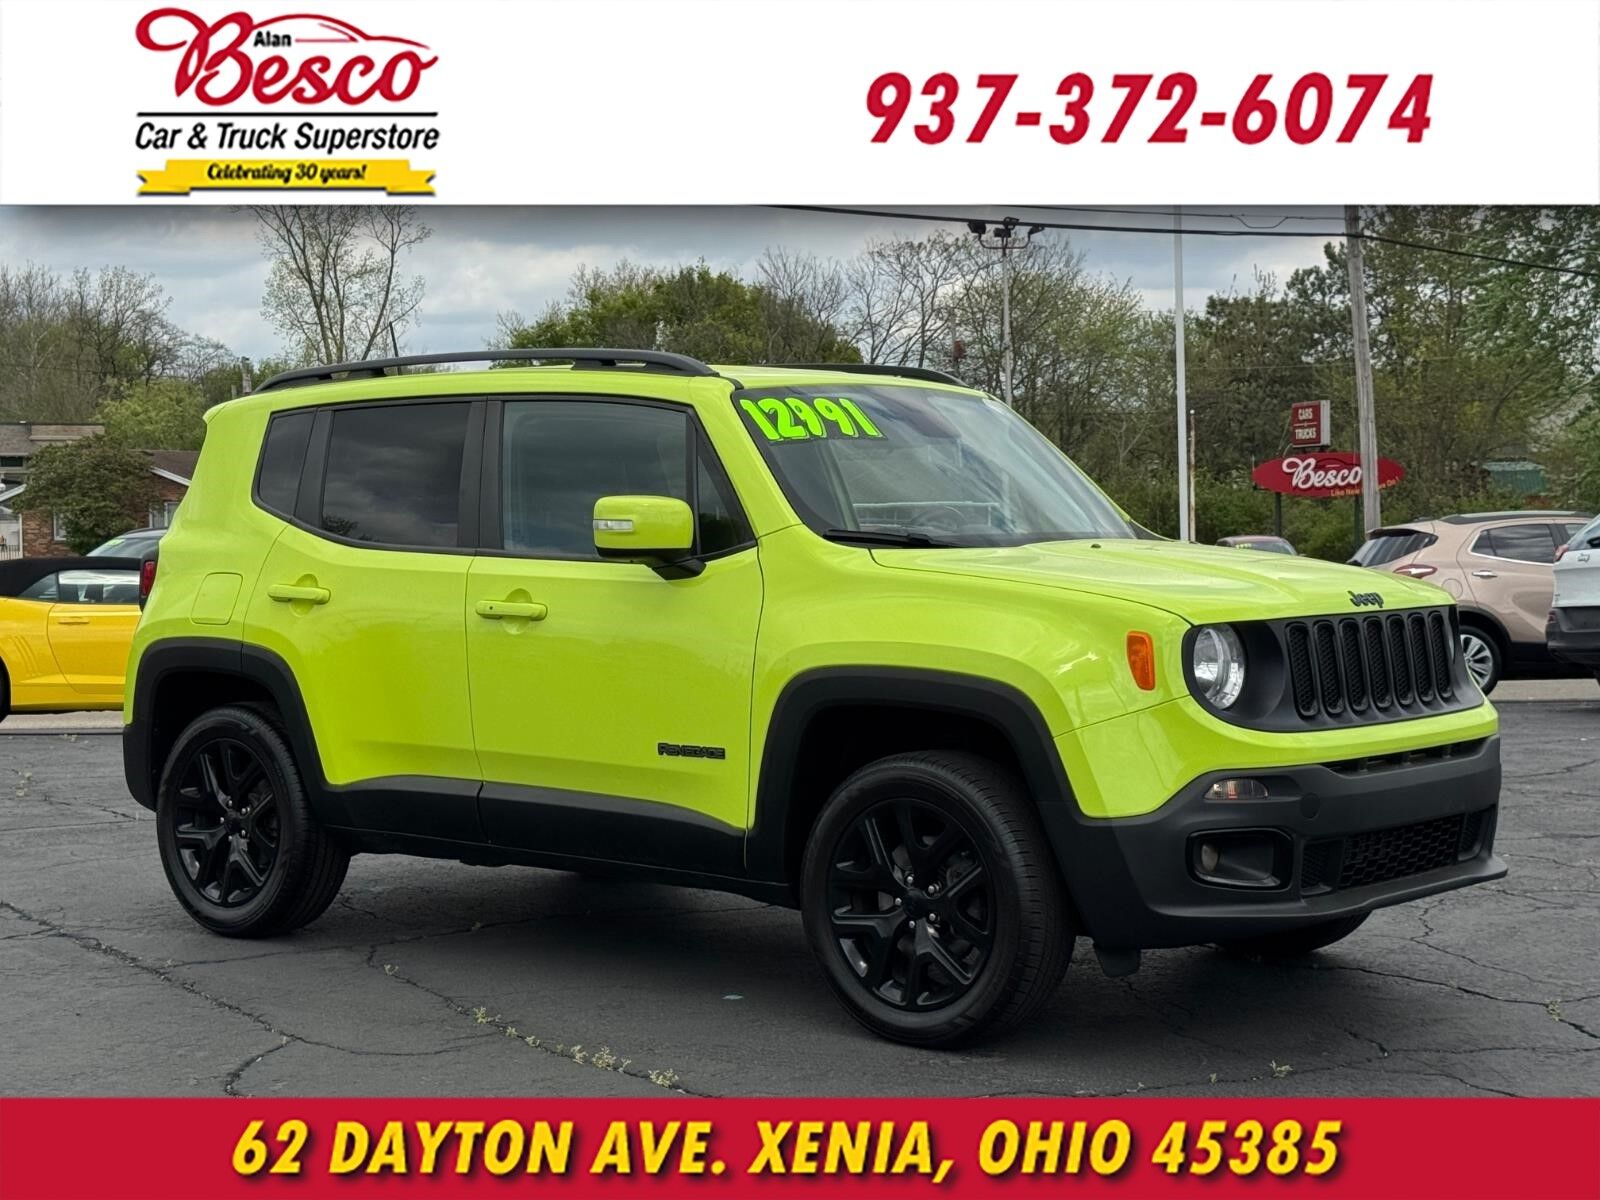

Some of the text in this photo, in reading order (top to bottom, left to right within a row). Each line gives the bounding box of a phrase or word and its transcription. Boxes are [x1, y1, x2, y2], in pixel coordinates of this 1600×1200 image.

[739, 398, 884, 441] 12991
[1298, 408, 1313, 420] CARS
[1295, 427, 1317, 440] TRUCKS
[1282, 457, 1362, 489] Besco
[1347, 590, 1384, 608] Jeep
